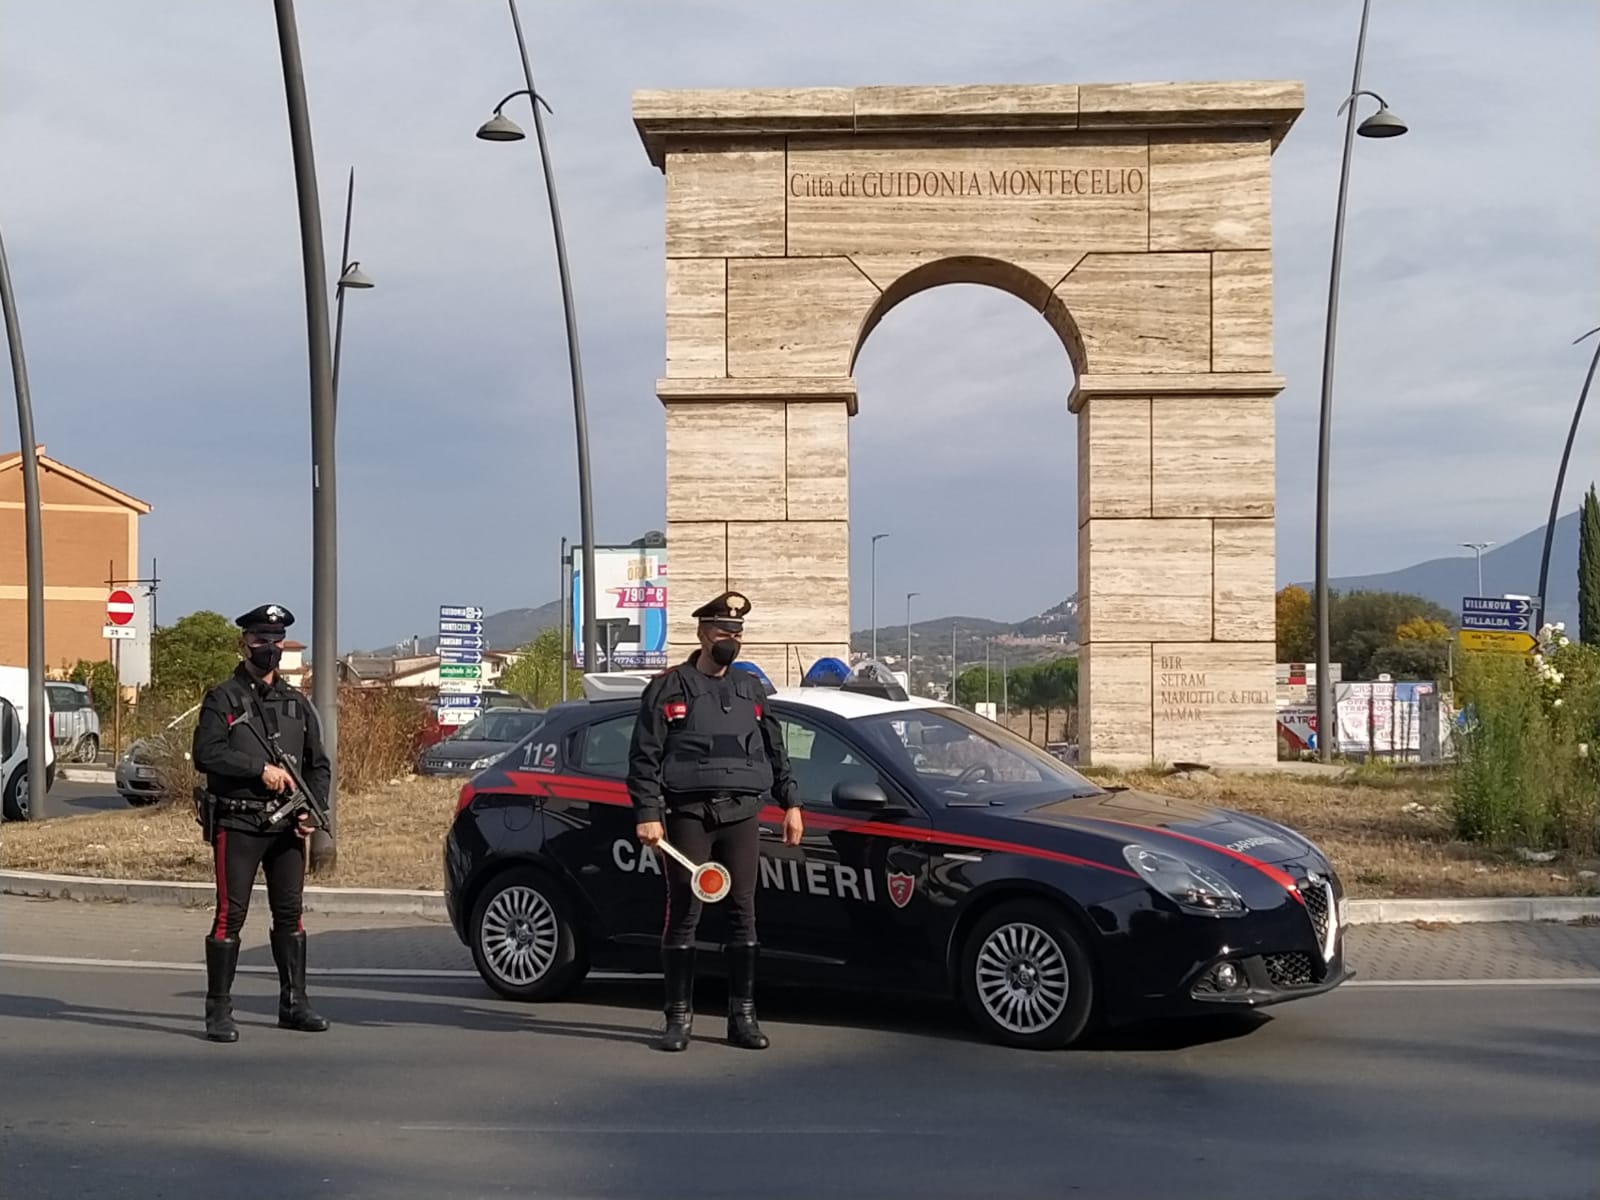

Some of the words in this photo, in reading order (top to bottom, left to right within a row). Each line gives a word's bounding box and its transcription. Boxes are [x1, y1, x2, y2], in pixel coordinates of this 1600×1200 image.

[790, 172, 834, 198] Città
[839, 172, 855, 197] di
[862, 171, 982, 198] GUIDONIA
[989, 168, 1144, 197] MONTECELIO
[623, 588, 645, 602] 790
[1464, 599, 1511, 610] VILLANOVA
[1463, 616, 1510, 627] VILLALBA
[1161, 673, 1206, 687] SETRAM
[1161, 691, 1214, 704] MARIOTTI
[1230, 691, 1239, 704] &
[1241, 690, 1269, 704] FIGLI
[1283, 715, 1296, 724] LA
[523, 742, 557, 767] 112
